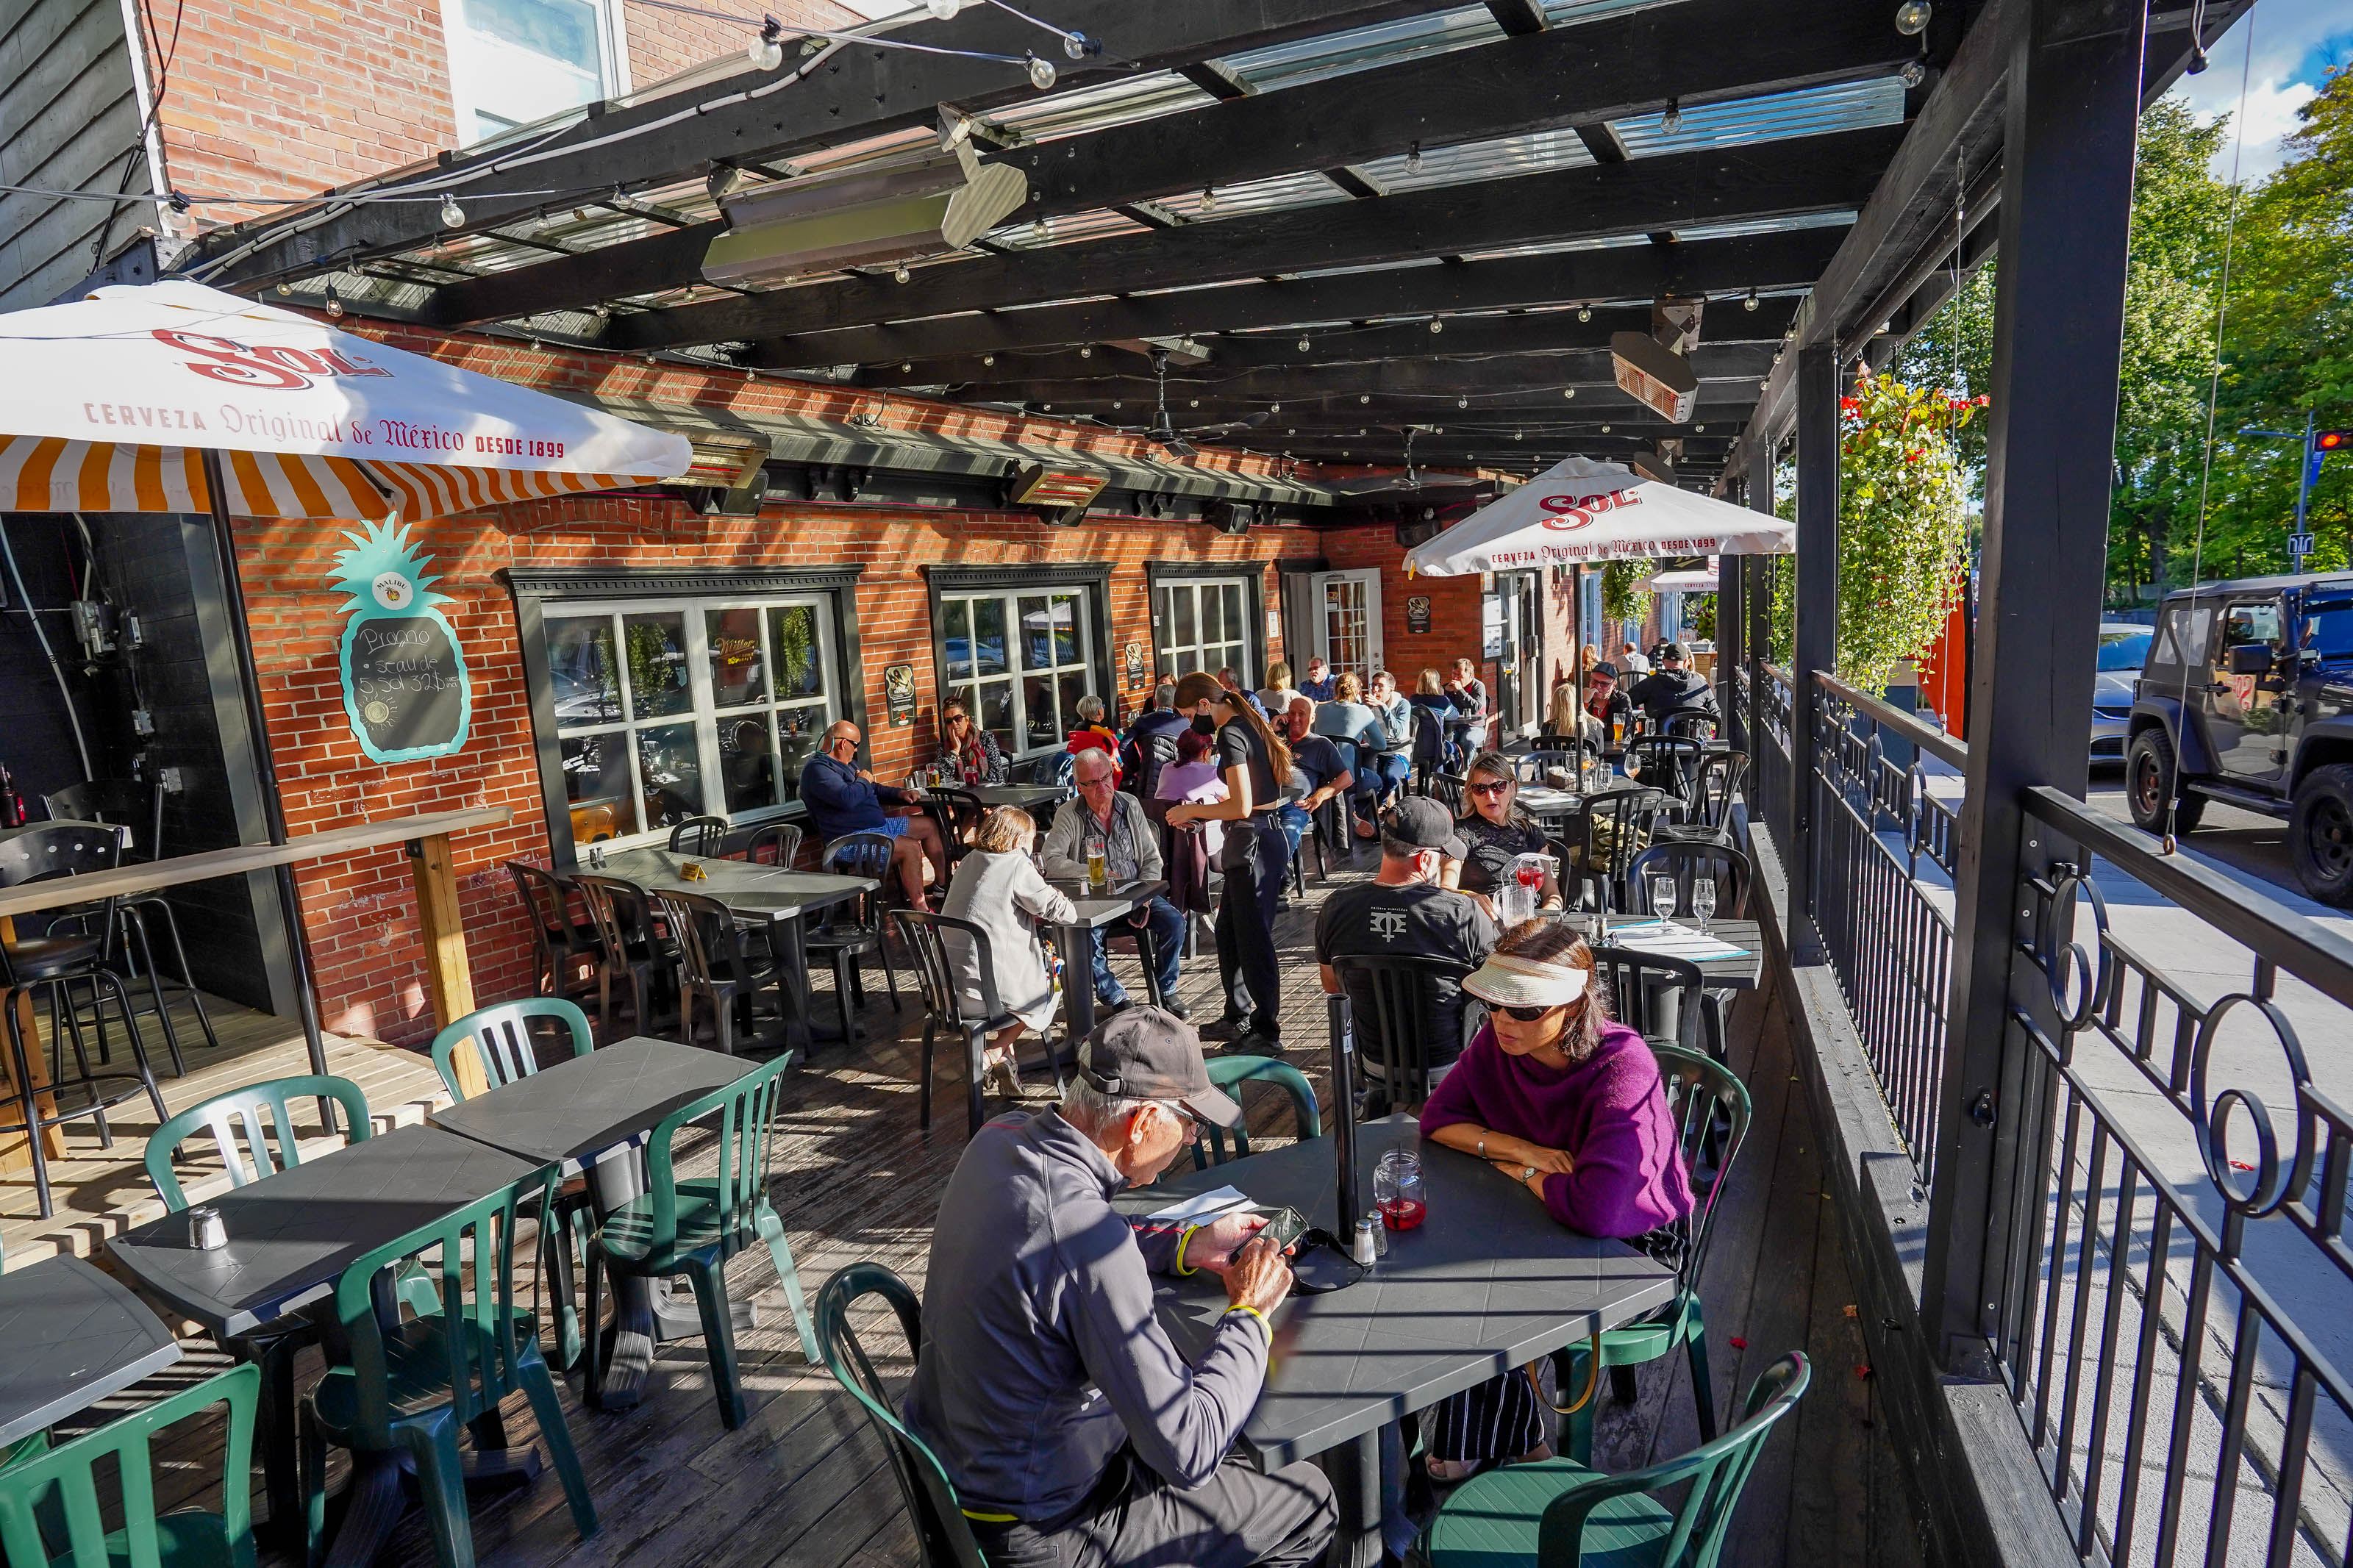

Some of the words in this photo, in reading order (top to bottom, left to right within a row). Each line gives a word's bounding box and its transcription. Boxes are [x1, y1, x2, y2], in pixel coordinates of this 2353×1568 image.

[84, 402, 207, 431] CERVEZA
[220, 404, 343, 444] Original
[351, 420, 373, 445] de
[379, 419, 465, 452] México
[475, 435, 524, 457] DESDE
[526, 440, 565, 458] 1899
[1491, 551, 1535, 564] CERVEZA
[1541, 540, 1593, 559] Original
[1597, 543, 1608, 555] de
[1612, 540, 1656, 554] México
[1660, 540, 1689, 550] DESDE
[1692, 537, 1715, 548] 1899
[376, 579, 407, 590] MALIBU
[360, 629, 429, 651] Promo
[375, 658, 417, 674] seau
[419, 654, 438, 672] de
[377, 673, 405, 693] Sol
